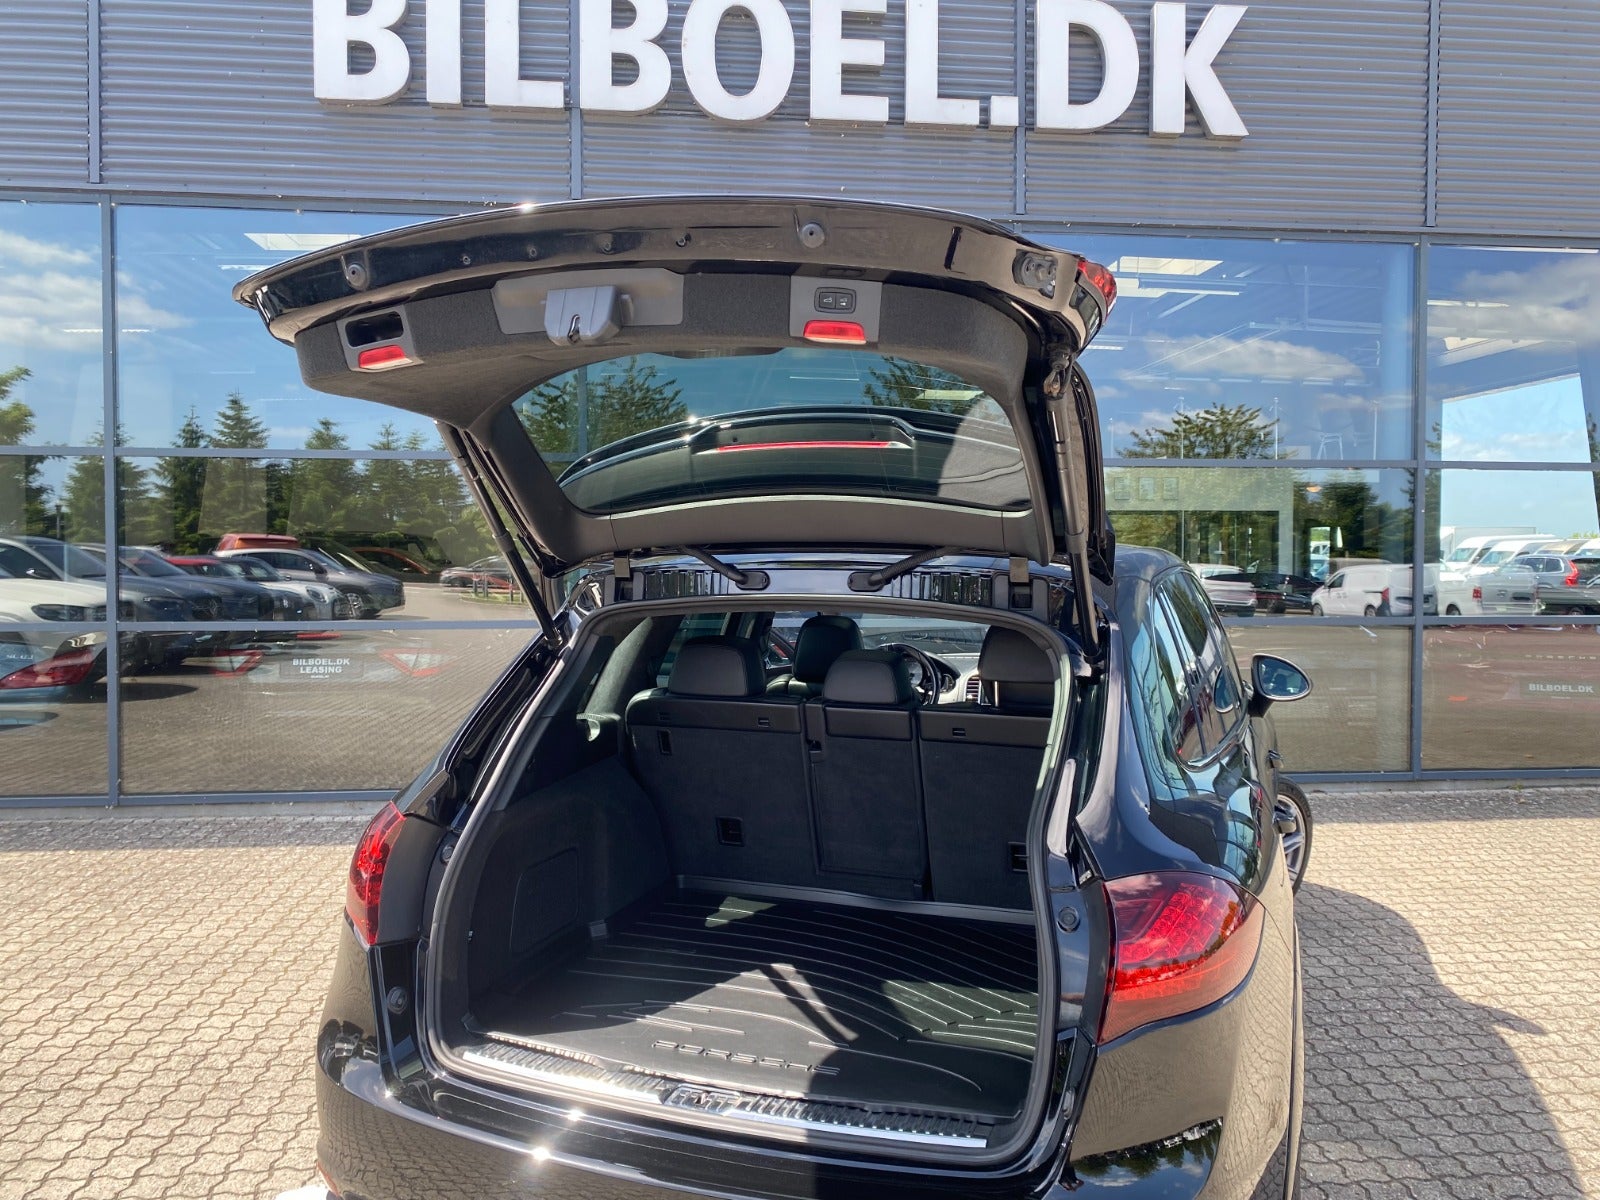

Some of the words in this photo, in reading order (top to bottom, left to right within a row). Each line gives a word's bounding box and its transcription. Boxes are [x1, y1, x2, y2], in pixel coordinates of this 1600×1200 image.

[312, 0, 1250, 137] BILBOEL.DK
[1528, 684, 1594, 692] BILBOEL.DK
[652, 1040, 841, 1076] PORSCHE
